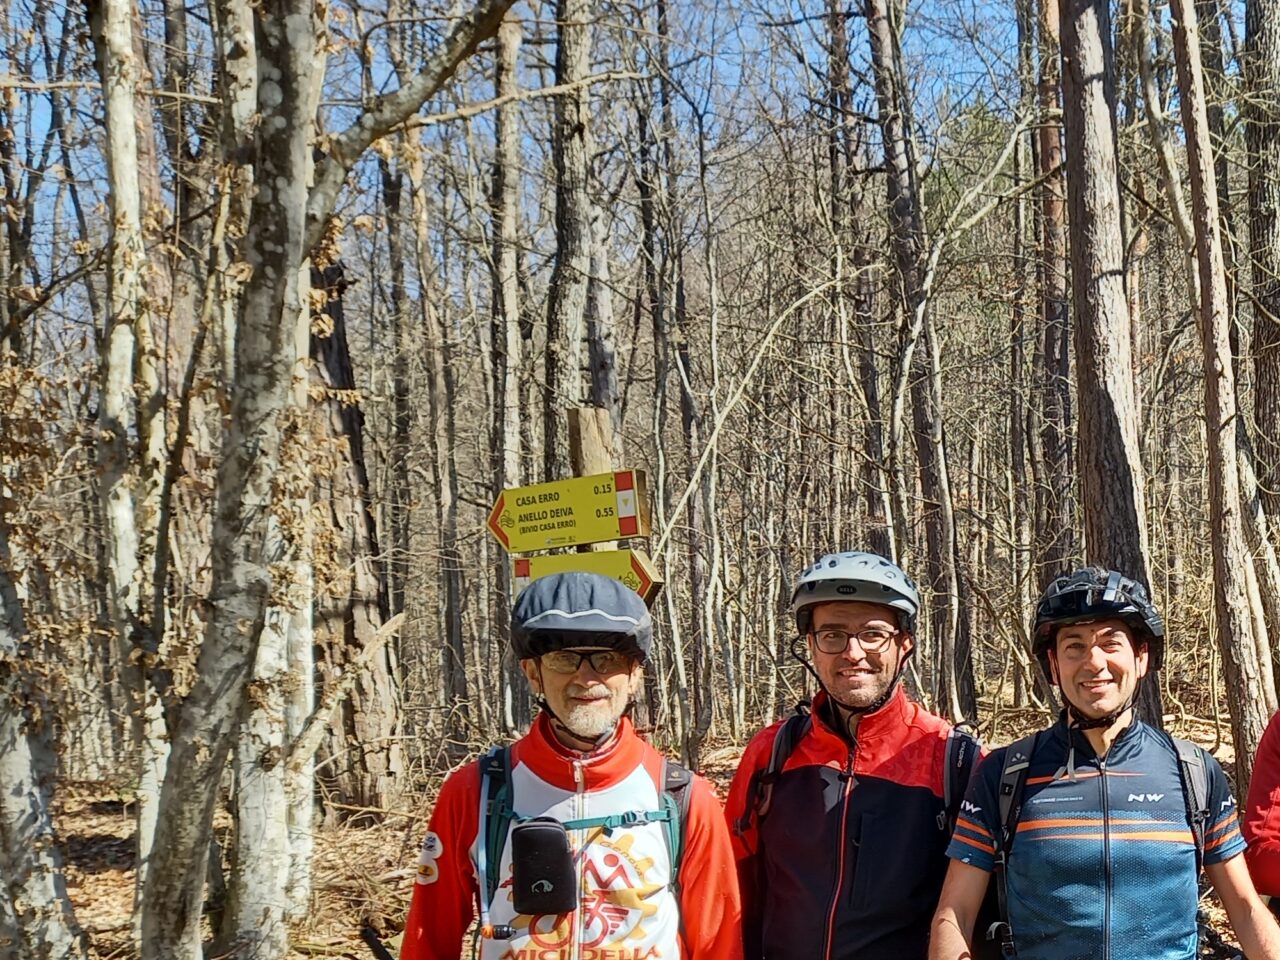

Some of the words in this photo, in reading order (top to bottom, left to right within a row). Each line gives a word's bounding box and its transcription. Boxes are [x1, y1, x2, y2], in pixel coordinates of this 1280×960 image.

[516, 494, 537, 507] CASA
[538, 492, 560, 504] ERRO
[593, 484, 612, 495] 0.15
[518, 510, 548, 524] ANELLO
[549, 507, 574, 520] DEIVA
[595, 507, 614, 518] 0.55
[539, 522, 556, 532] CASA
[556, 519, 577, 530] ERRO)
[1127, 793, 1165, 803] NW
